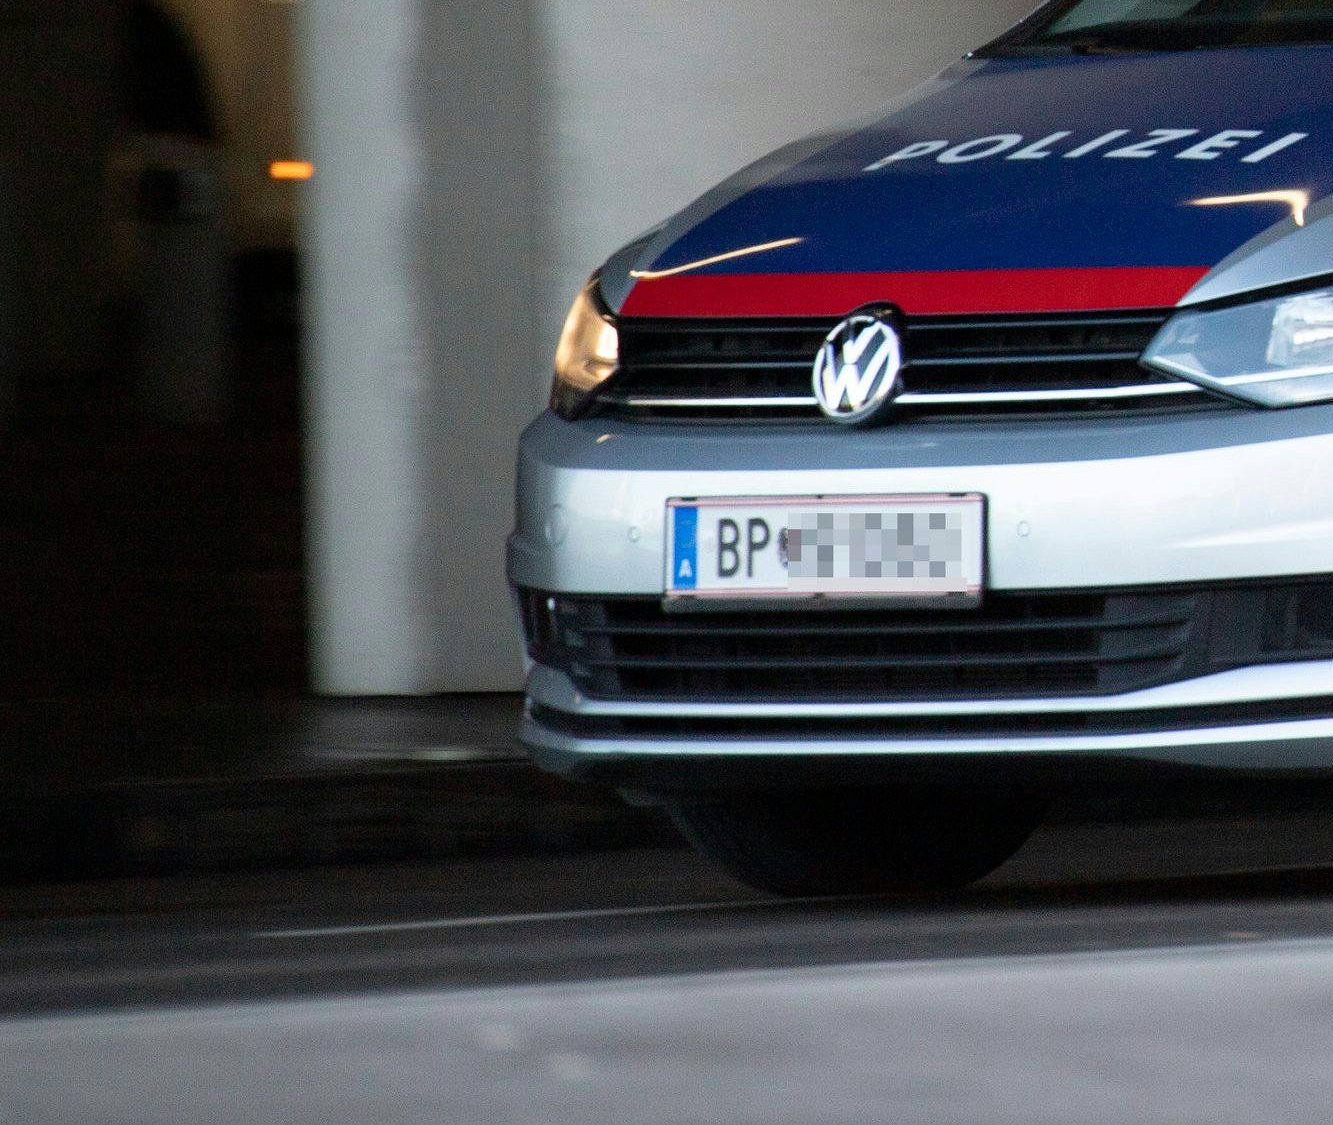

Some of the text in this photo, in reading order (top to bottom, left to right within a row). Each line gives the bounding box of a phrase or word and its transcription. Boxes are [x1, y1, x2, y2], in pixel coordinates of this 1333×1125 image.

[862, 129, 1309, 171] POLIZEI
[815, 317, 901, 417] VW
[678, 558, 693, 578] A
[717, 517, 771, 579] BP
